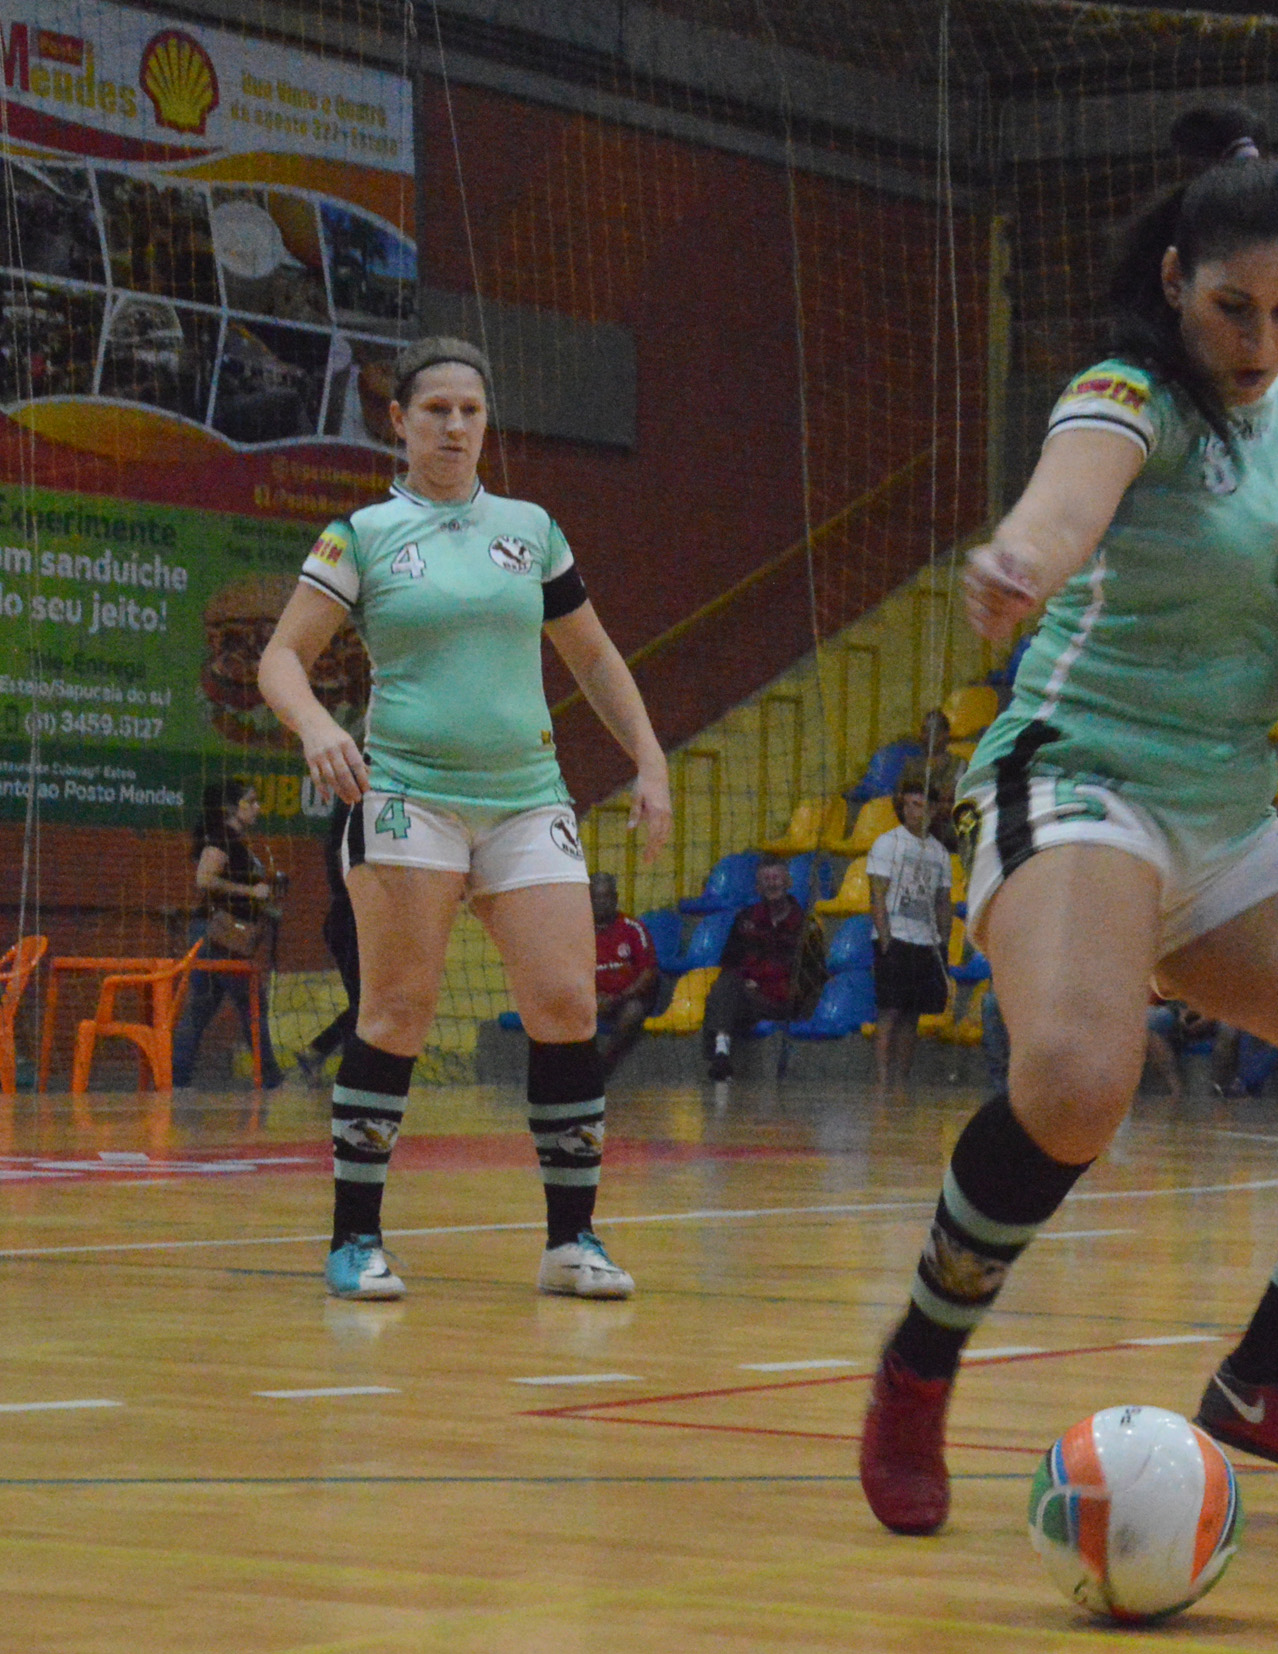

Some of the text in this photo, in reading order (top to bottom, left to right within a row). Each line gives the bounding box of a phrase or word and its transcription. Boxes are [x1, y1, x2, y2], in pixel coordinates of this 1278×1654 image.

[0, 22, 137, 118] Mendes
[0, 546, 32, 573] m
[391, 541, 426, 578] 4
[0, 582, 167, 633] o seu jeito!
[64, 779, 116, 802] Posto
[119, 783, 184, 806] Mendes
[233, 774, 335, 817] UBW
[375, 799, 411, 840] 4
